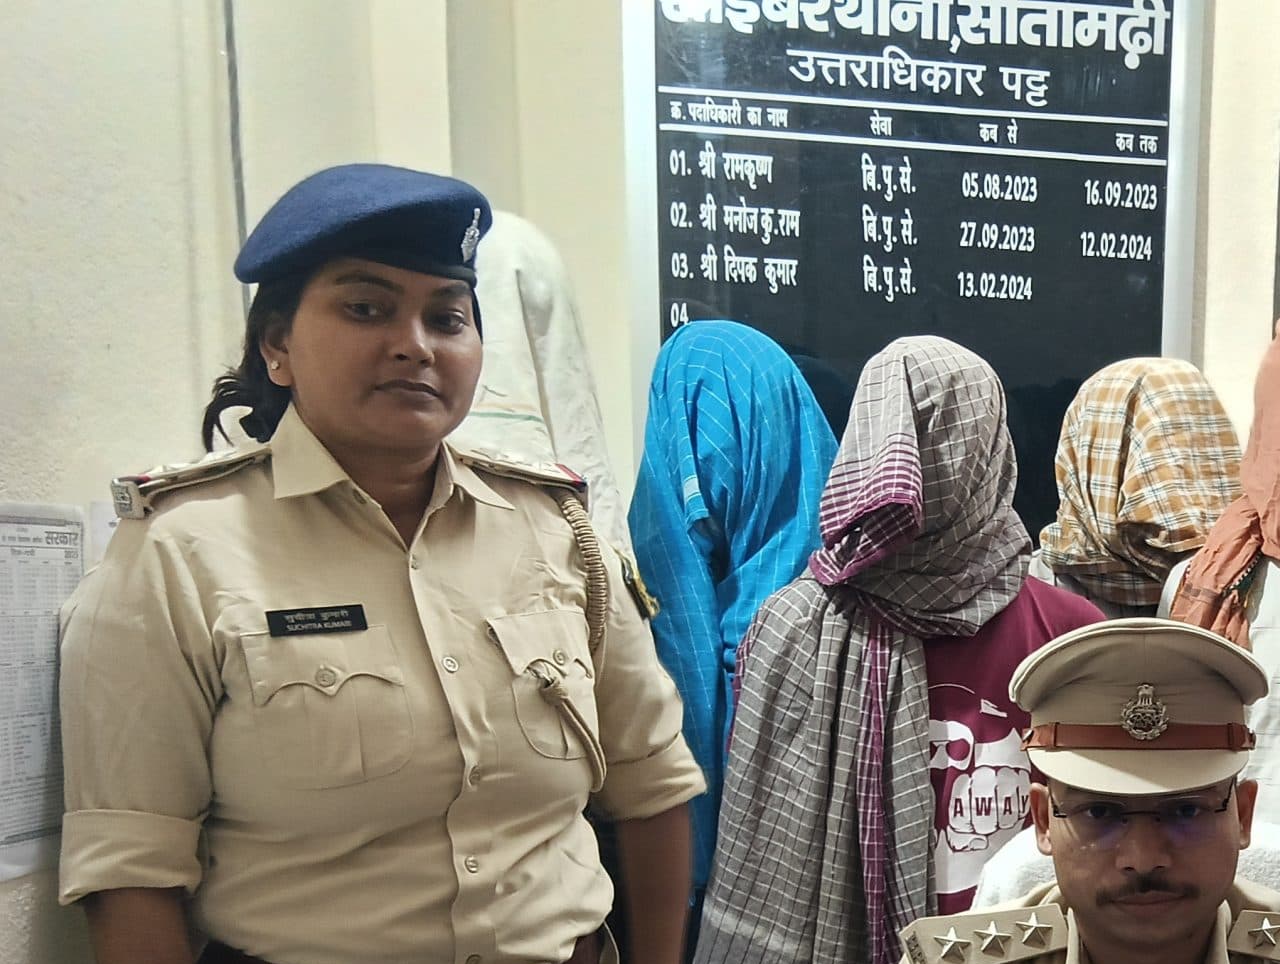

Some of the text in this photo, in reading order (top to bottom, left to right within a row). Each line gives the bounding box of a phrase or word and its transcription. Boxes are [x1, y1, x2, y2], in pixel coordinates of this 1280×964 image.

[786, 45, 986, 97] उत्तराधिकार
[746, 106, 762, 127] का
[766, 107, 788, 128] नाम
[869, 109, 892, 136] सेवा
[979, 118, 1018, 144] कब से
[1115, 132, 1159, 153] कब तक
[669, 149, 692, 176] 01.
[698, 140, 773, 189] श्री रामकृष्ण
[961, 171, 1038, 202] 05.08.2023
[1084, 179, 1158, 210] 16.09.2023
[670, 201, 693, 228] 02.
[699, 193, 717, 231] श्री
[959, 221, 1035, 252] 27.09.2023
[1080, 231, 1152, 261] 12.02.2024
[671, 252, 694, 279] 03.
[700, 244, 718, 282] श्री
[764, 257, 798, 293] कुमार
[957, 271, 1032, 300] 13.02.2024
